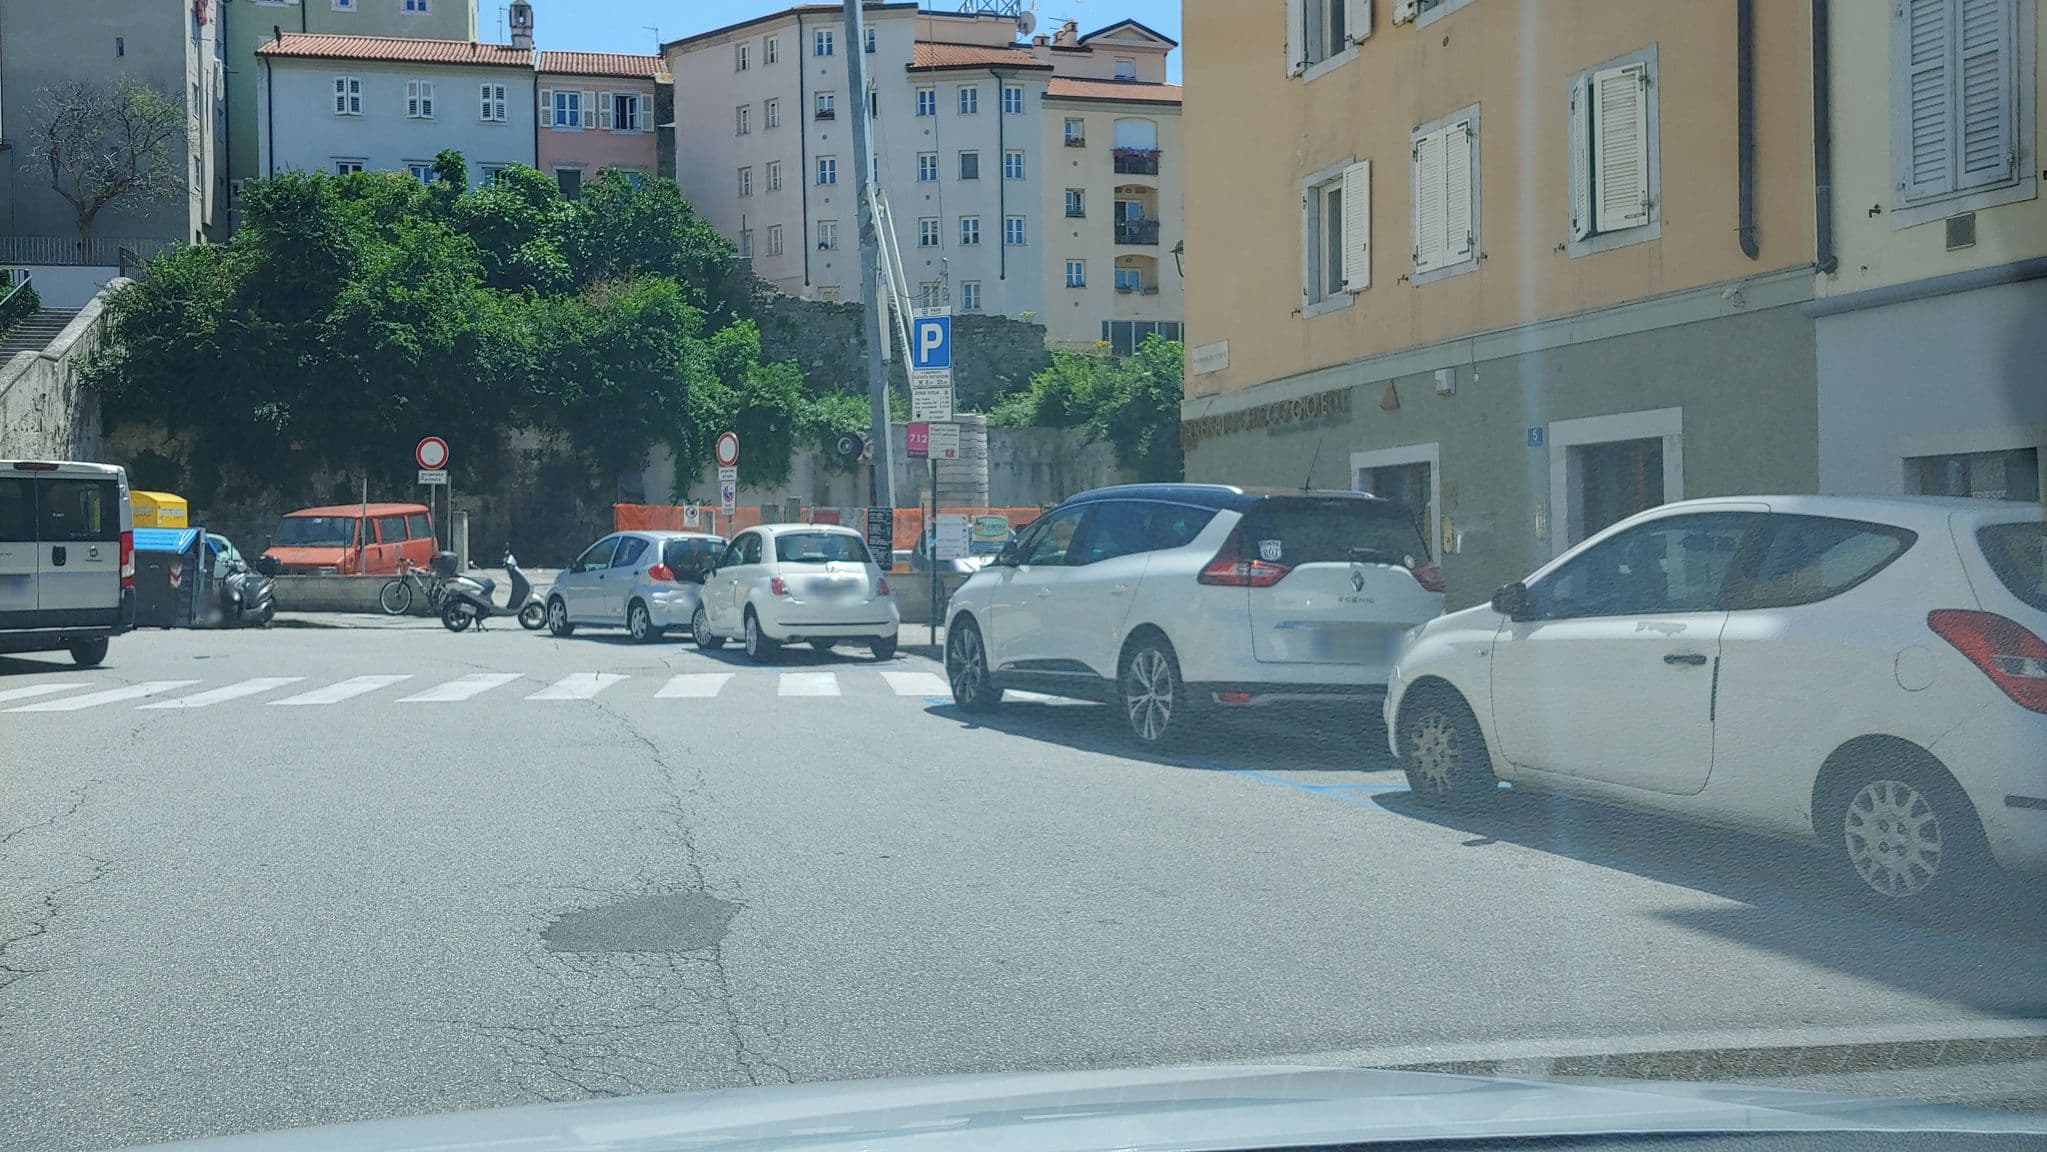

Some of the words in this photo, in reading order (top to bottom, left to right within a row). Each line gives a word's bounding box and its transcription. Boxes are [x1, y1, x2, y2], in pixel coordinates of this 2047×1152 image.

[921, 323, 943, 363] P
[909, 433, 928, 444] 712
[1532, 429, 1538, 441] 5
